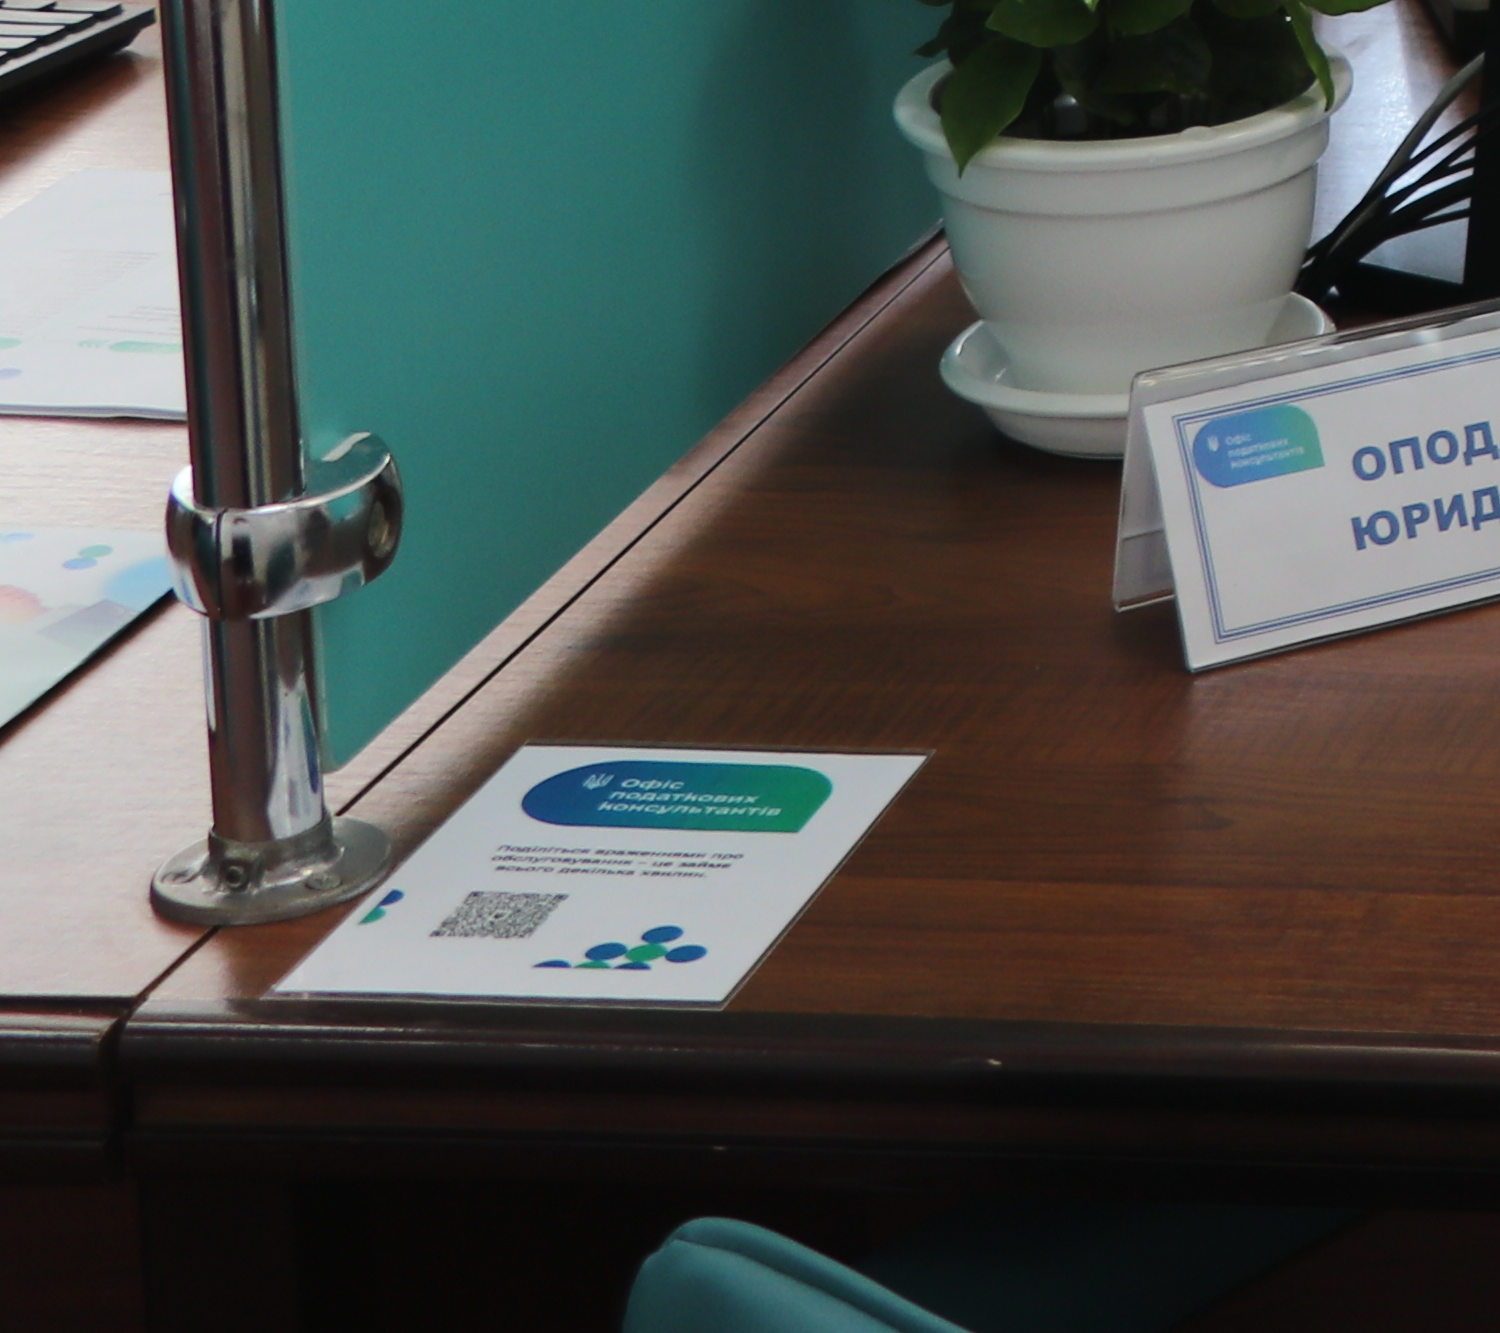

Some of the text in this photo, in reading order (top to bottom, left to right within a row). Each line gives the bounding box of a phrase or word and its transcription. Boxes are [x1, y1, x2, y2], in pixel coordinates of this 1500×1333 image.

[621, 778, 684, 791] Офіс
[608, 791, 760, 804] податкових
[597, 800, 781, 816] консультантів
[496, 844, 745, 861] Поділіться враженнями про
[491, 854, 633, 866] обслуговування
[678, 861, 732, 870] займе
[495, 864, 555, 873] всього
[558, 866, 635, 877] декілька
